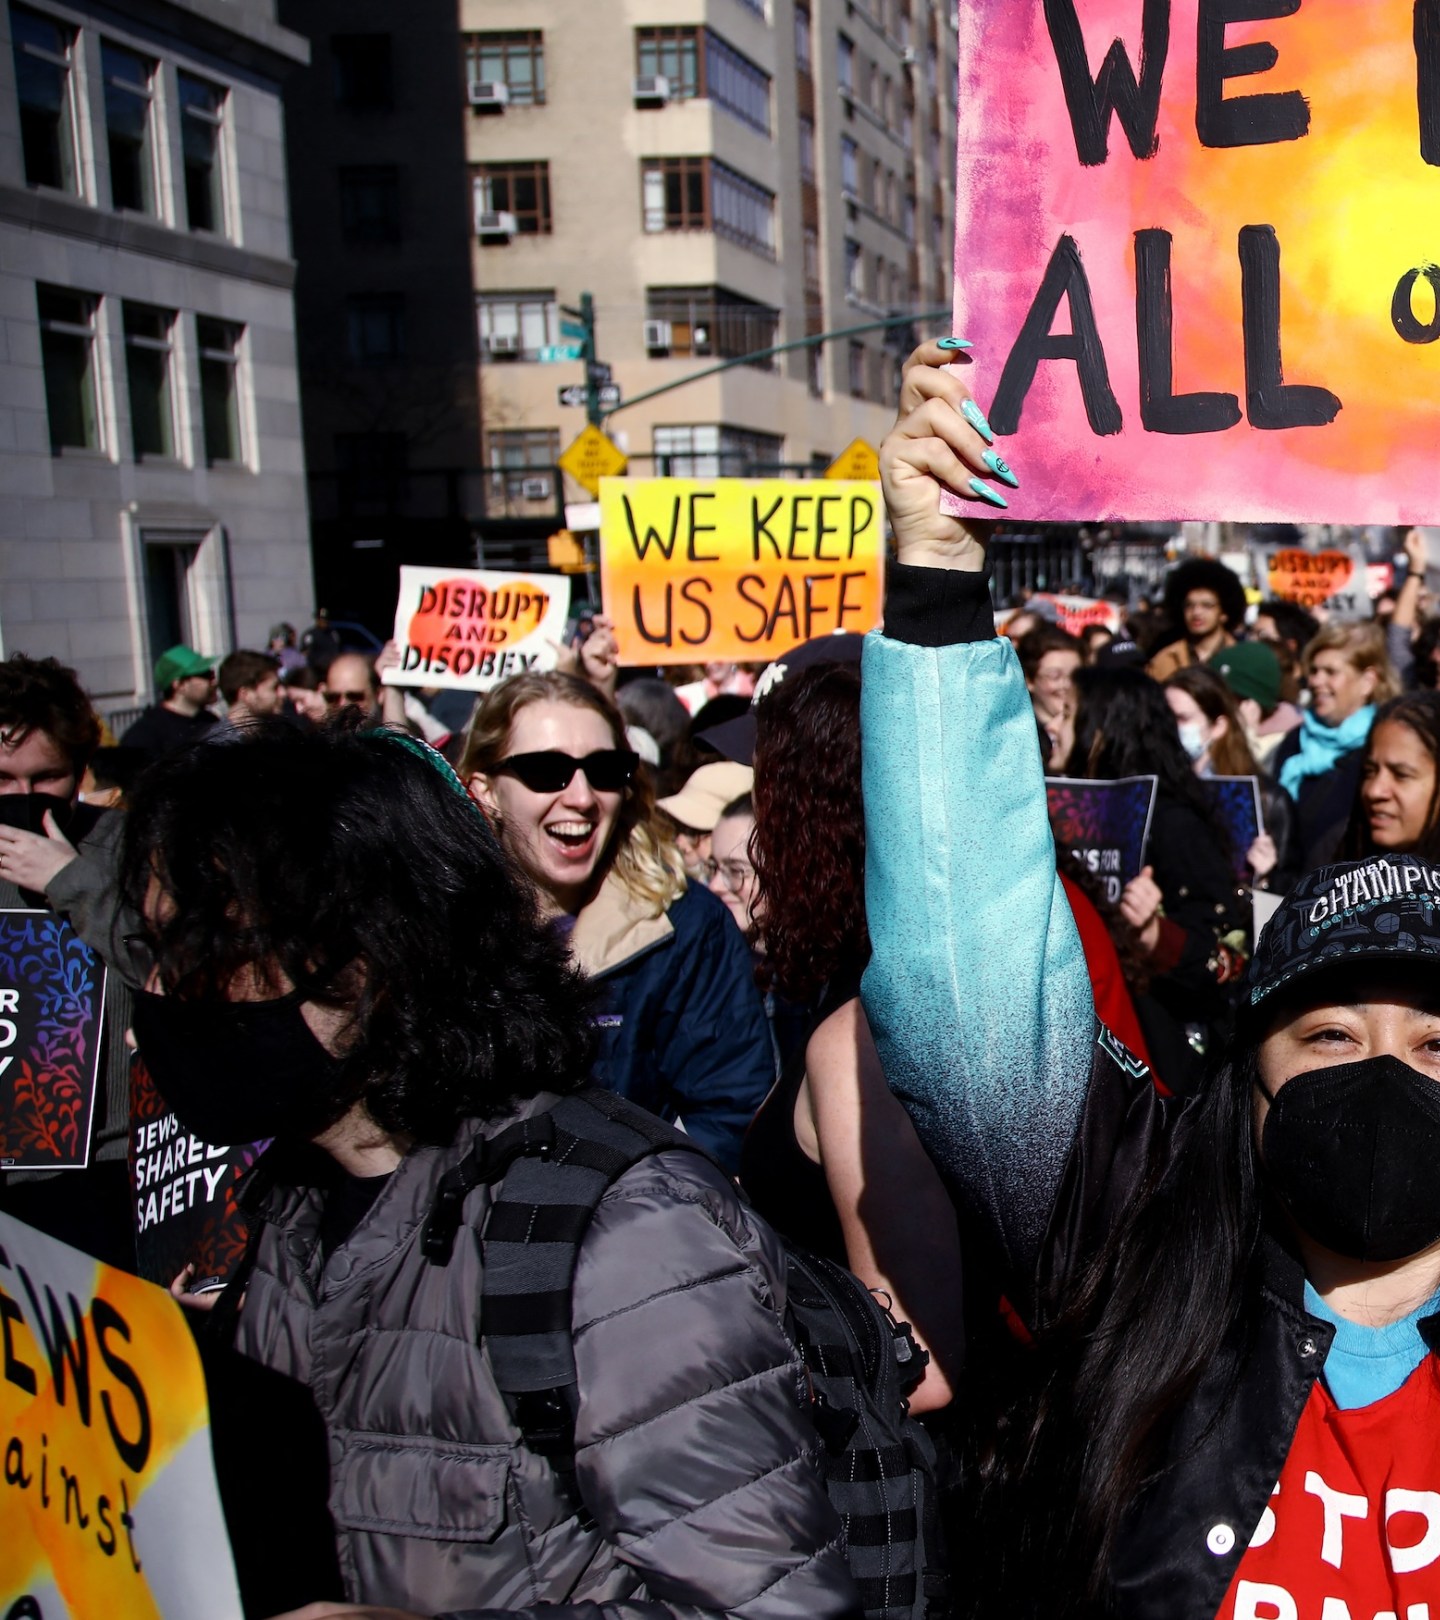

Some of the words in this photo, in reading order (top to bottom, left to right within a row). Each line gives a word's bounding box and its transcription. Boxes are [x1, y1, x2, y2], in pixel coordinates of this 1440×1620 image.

[1043, 0, 1311, 167] WE
[988, 224, 1344, 436] ALL
[622, 492, 720, 561] WE
[752, 496, 874, 561] KEEP
[417, 584, 549, 623] DISRUPT
[445, 623, 508, 644] AND
[633, 576, 713, 647] US
[136, 1113, 179, 1153] JEWS
[137, 1163, 229, 1234] SAFETY
